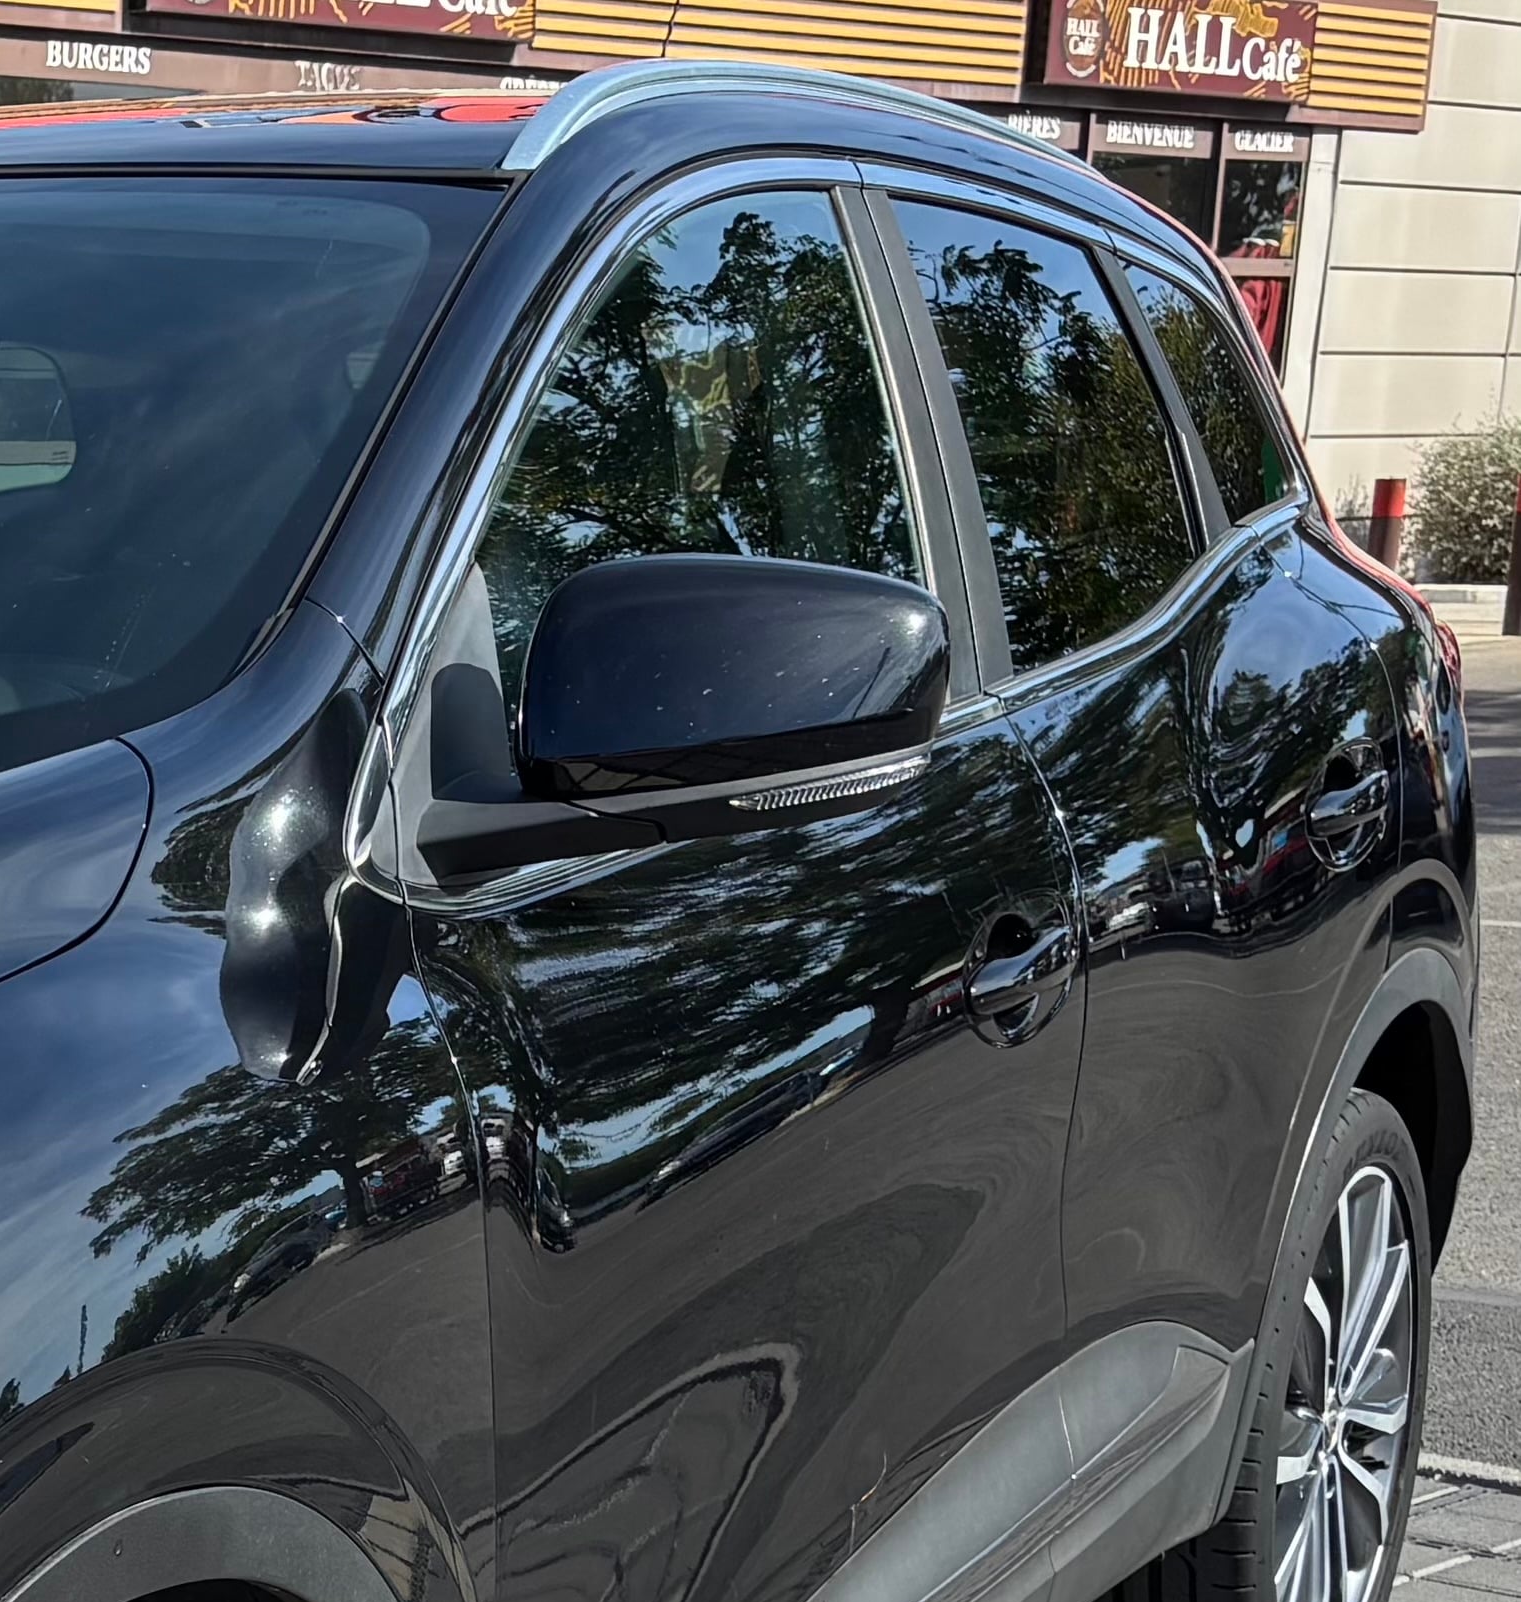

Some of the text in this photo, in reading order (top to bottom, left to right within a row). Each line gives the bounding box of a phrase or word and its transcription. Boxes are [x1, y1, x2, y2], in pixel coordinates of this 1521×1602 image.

[1067, 17, 1101, 38] HALL
[45, 40, 151, 74] BURGERS
[1124, 6, 1302, 83] HALL Café
[1106, 120, 1196, 149] BIENVENUE
[1234, 130, 1294, 153] GLACIER
